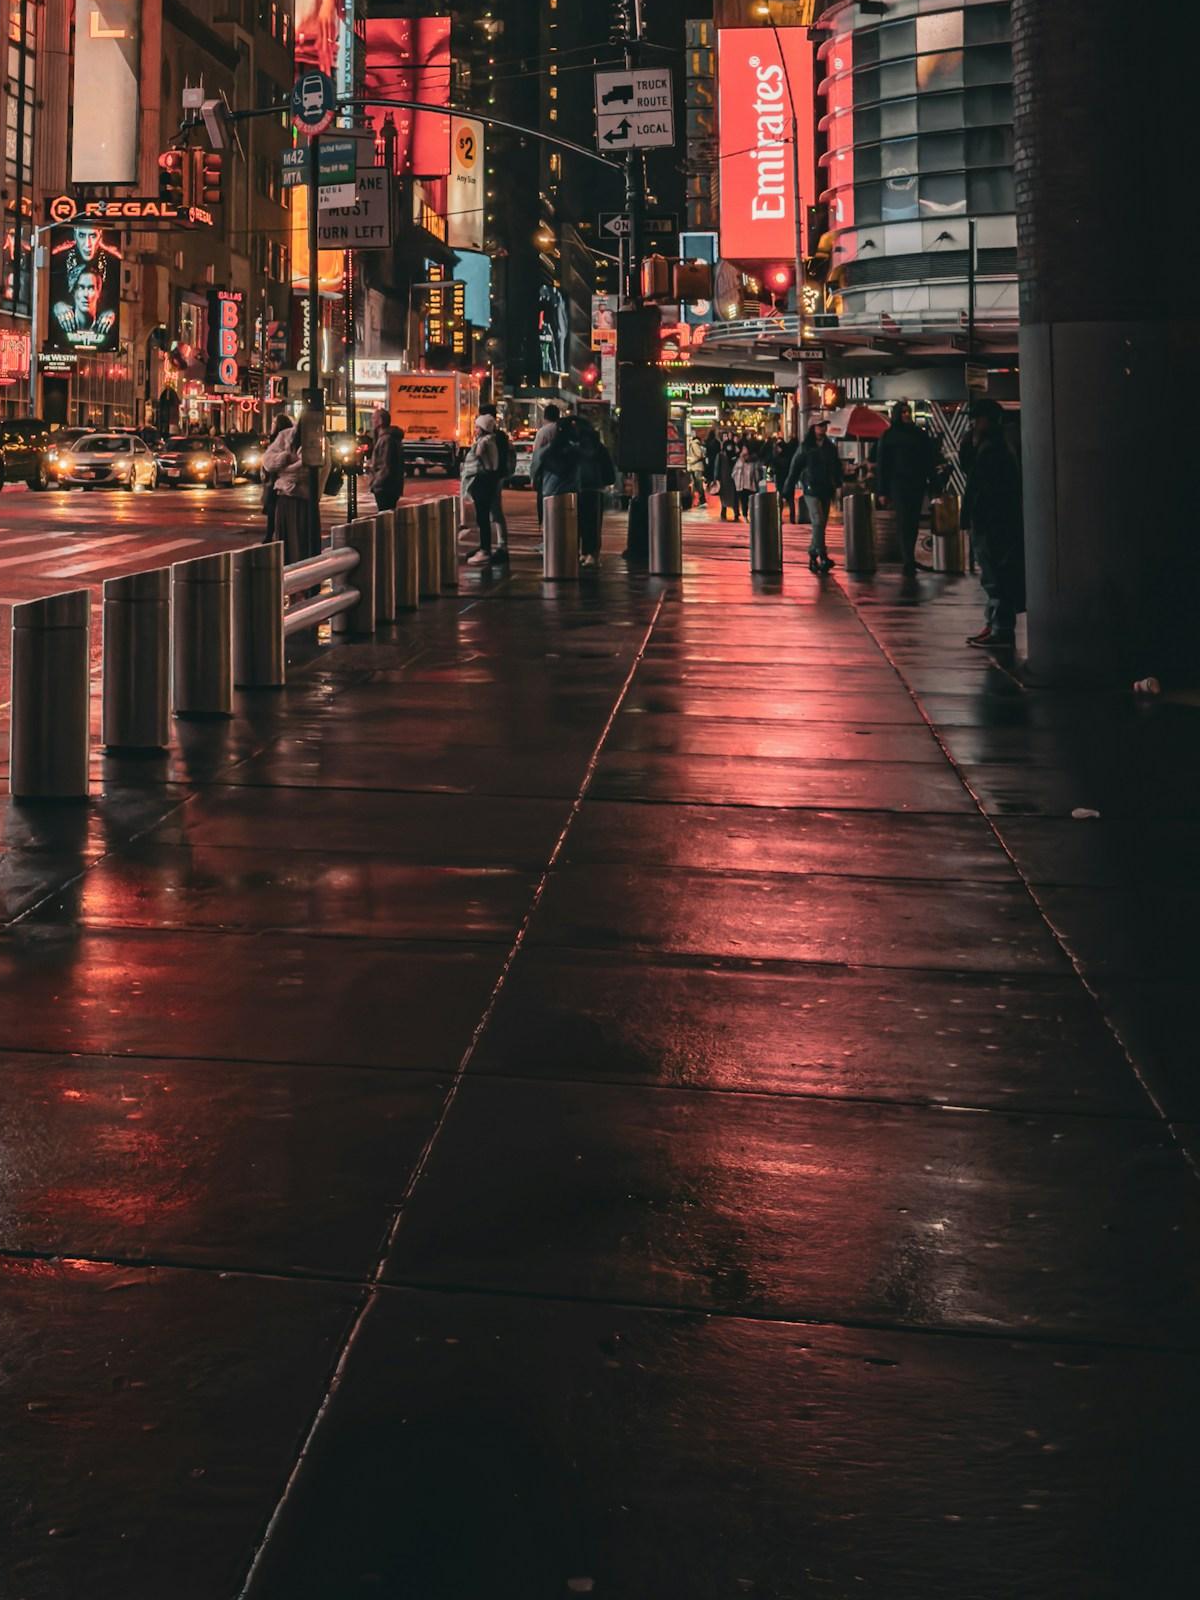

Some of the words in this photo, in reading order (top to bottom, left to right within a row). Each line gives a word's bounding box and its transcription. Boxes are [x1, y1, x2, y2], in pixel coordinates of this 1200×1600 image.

[637, 79, 668, 90] TRUCK
[637, 96, 668, 107] ROUTE
[637, 123, 669, 135] LOCAL
[283, 150, 304, 166] M42
[283, 172, 302, 185] MTA
[358, 176, 383, 190] ANE
[85, 202, 178, 217] REGAL
[614, 220, 630, 231] ON
[355, 225, 384, 239] LEFT
[219, 300, 239, 386] BBQ
[51, 353, 78, 362] WESTIN
[397, 384, 449, 394] PENSKE
[725, 387, 770, 397] IMAX
